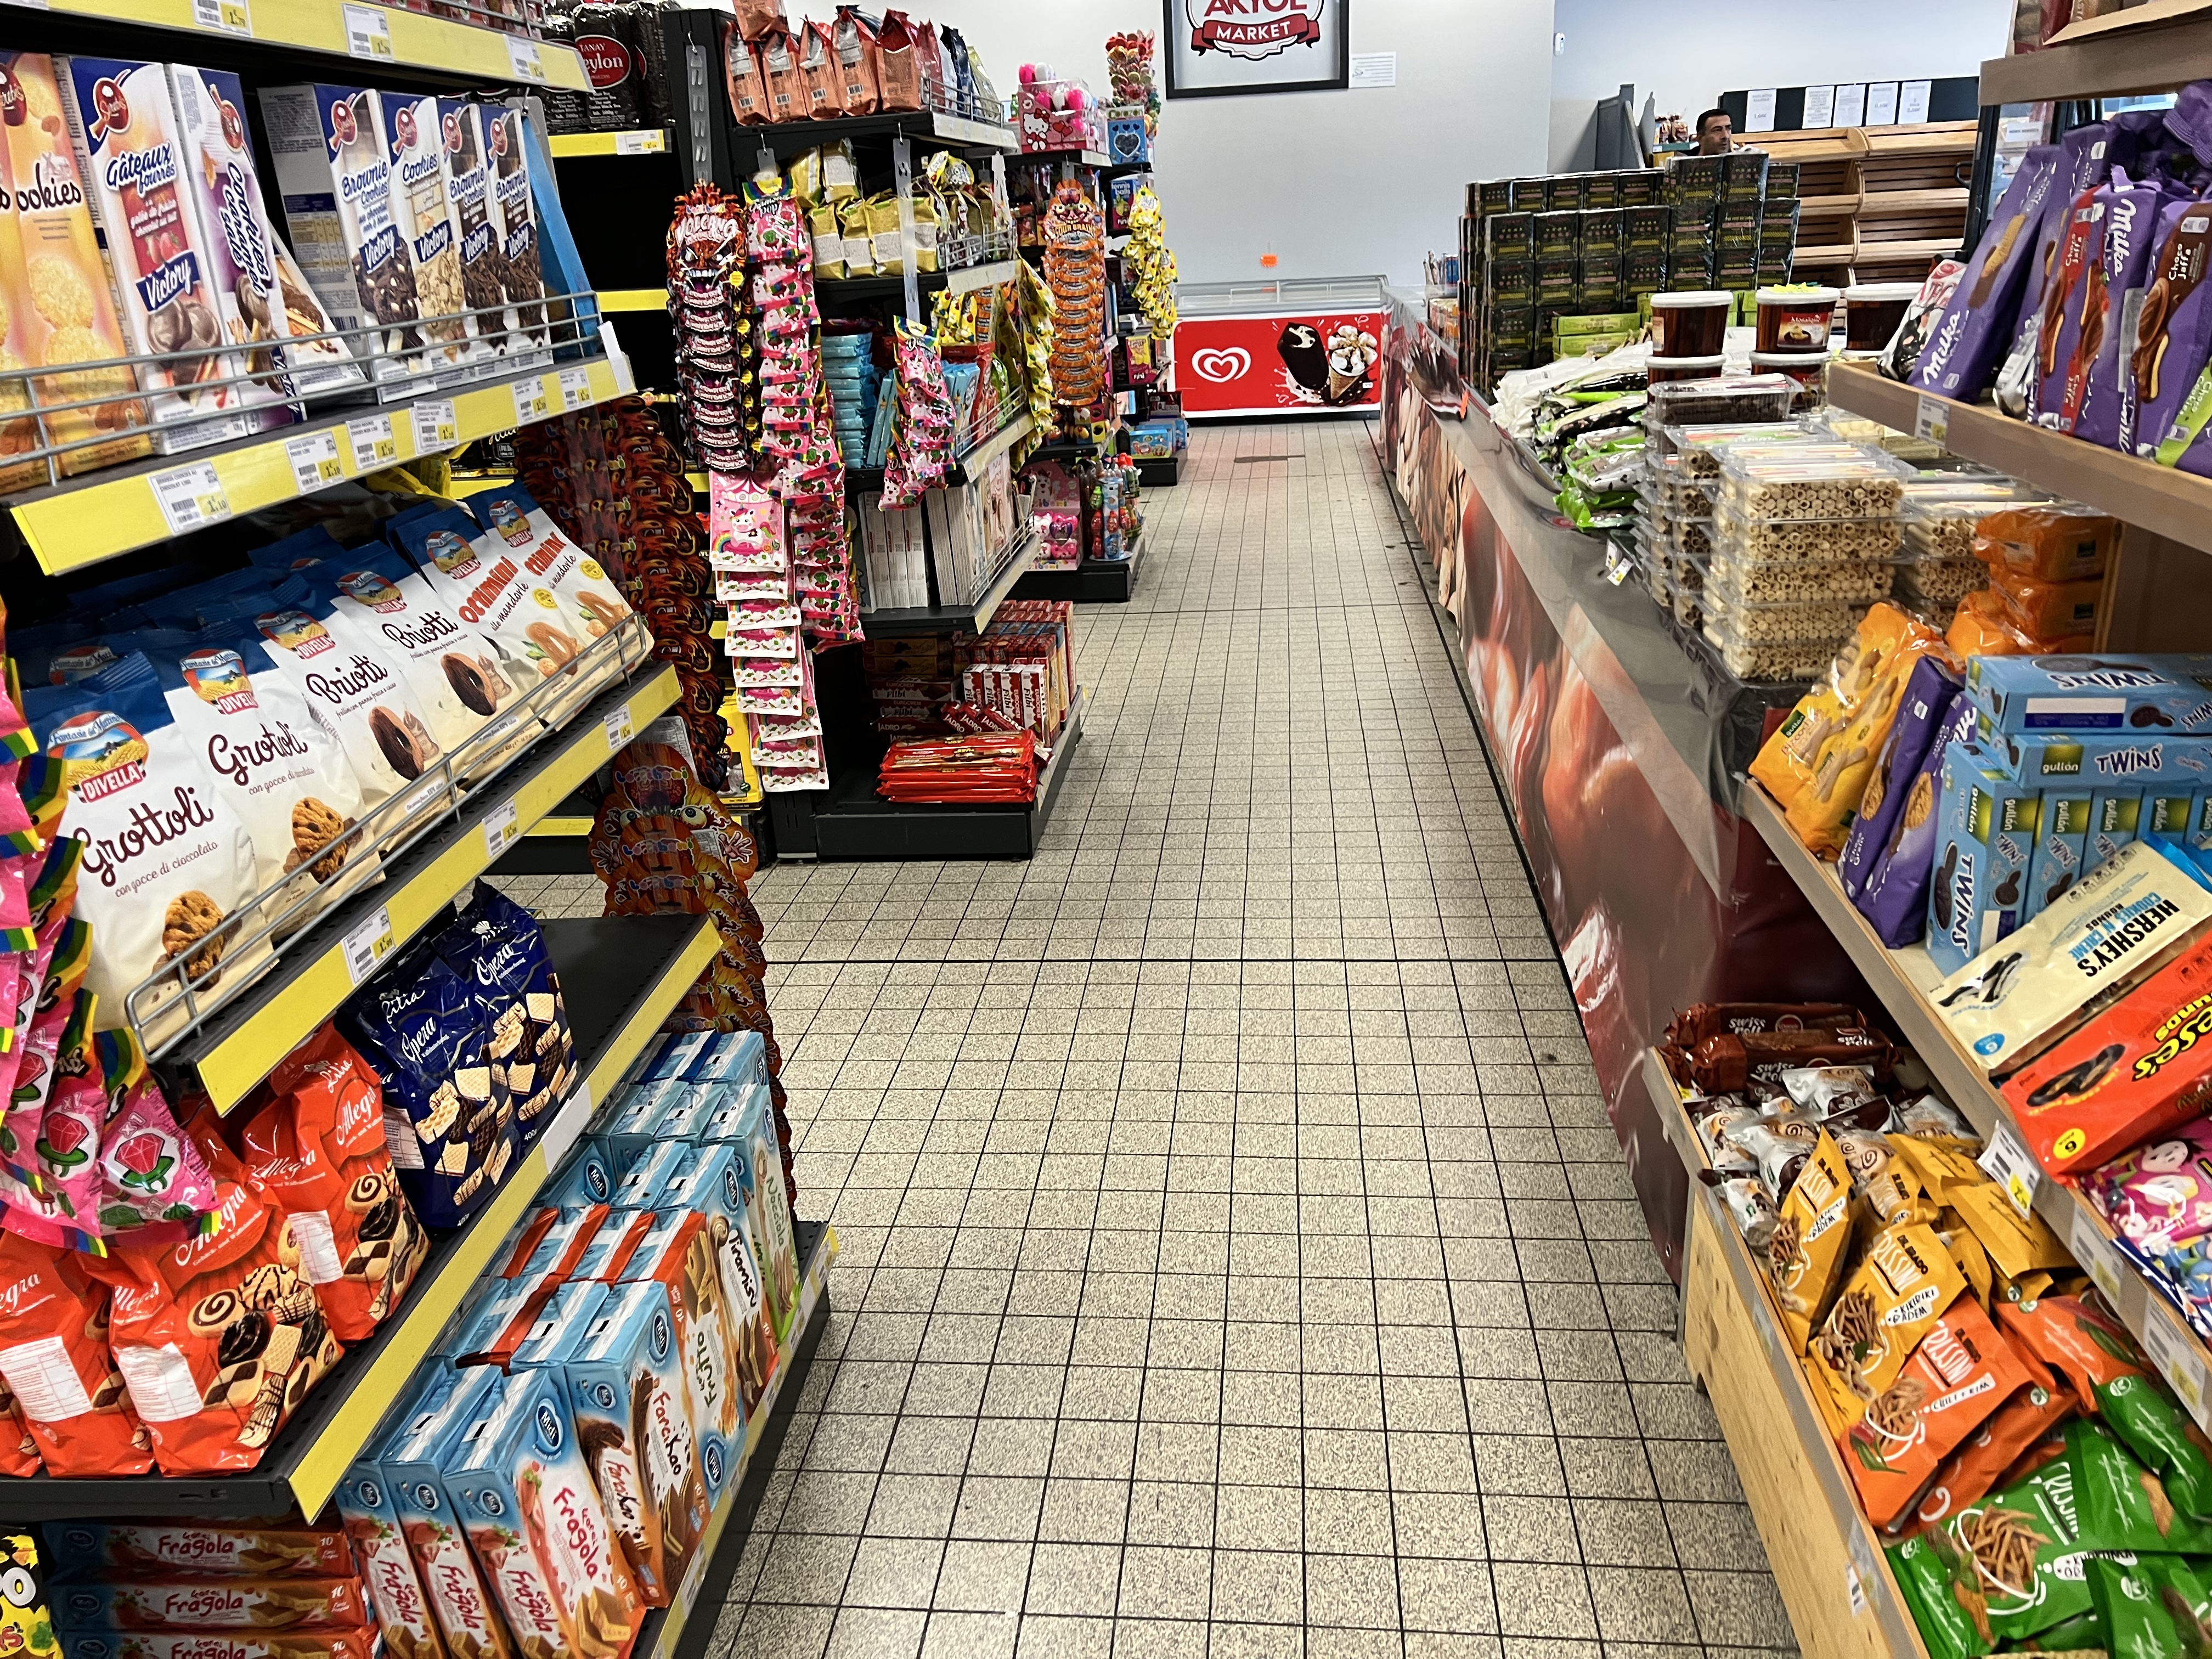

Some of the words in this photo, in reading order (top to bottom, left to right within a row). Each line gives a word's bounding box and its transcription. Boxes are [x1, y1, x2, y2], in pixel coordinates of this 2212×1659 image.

[1216, 21, 1290, 40] MARKET
[579, 43, 606, 52] TANAY
[585, 52, 623, 74] eylon
[108, 143, 173, 186] Gâteaux
[342, 163, 388, 195] Brownie
[402, 155, 437, 182] Cookies
[15, 163, 82, 212] ookies
[361, 182, 388, 205] Cookies
[450, 168, 485, 196] Brownie
[496, 168, 526, 196] Brownie
[228, 162, 270, 280] Cookies
[676, 215, 737, 247] VOLCANO
[223, 185, 267, 297] caramel
[366, 233, 394, 269] Victory
[421, 225, 448, 260] Victory
[465, 227, 489, 262] Victory
[508, 225, 532, 260] Victory
[2113, 199, 2137, 277] Milka
[145, 263, 192, 308] Victory
[1923, 311, 1961, 385] Milka
[510, 531, 532, 548] DIVELLA
[498, 582, 529, 627] mandorle
[382, 611, 459, 649] Briotti
[300, 637, 332, 658] DIVELLA
[306, 654, 388, 704] Briotti
[2050, 673, 2177, 689] TWINS
[359, 695, 373, 710] panna
[386, 682, 397, 693] cacao
[1002, 688, 1012, 711] Filbi
[1024, 687, 1032, 709] Filbi
[878, 723, 900, 731] JADRO
[944, 714, 965, 733] JADRO
[961, 714, 982, 733] JADRO
[998, 711, 1025, 731] ADRO
[2043, 757, 2079, 773] gullón
[2096, 747, 2162, 775] TWINS
[84, 766, 141, 799] DIVELLA
[1968, 788, 1978, 833] gullón
[2004, 799, 2016, 831] gullón
[2056, 800, 2068, 833] gullón
[2104, 799, 2117, 831] gullón
[2154, 799, 2166, 831] gullón
[73, 786, 215, 887] Grottoli
[1995, 833, 2028, 868] TWINS
[2047, 835, 2080, 869] TWINS
[115, 881, 133, 899] con
[132, 870, 159, 894] gocce
[159, 862, 172, 876] di
[172, 840, 219, 870] cioccolato
[1951, 854, 1975, 958] TWINS
[2085, 903, 2124, 931] ROUNDS
[2114, 891, 2163, 924] COOKIES
[2067, 926, 2104, 962] CREME
[2077, 898, 2180, 978] HERSHEY'S
[476, 940, 522, 987] Opera
[1729, 1016, 1766, 1030] swiss
[402, 1016, 437, 1063] Opera
[121, 1113, 146, 1139] x1
[589, 1167, 605, 1198] Midi
[726, 1173, 738, 1198] Midi
[766, 1176, 784, 1248] Nocciola
[656, 1318, 668, 1352] Midi
[540, 1409, 559, 1448] Midi
[653, 1390, 682, 1476] FarciKao
[708, 1446, 722, 1479] Midi
[694, 1481, 703, 1496] 10
[158, 1534, 234, 1559] Fragola
[320, 1536, 334, 1547] 10
[553, 1486, 599, 1580] Fragola
[331, 1585, 345, 1599] 10
[377, 1559, 418, 1626] Fragola
[438, 1564, 485, 1632] Fragola
[617, 1575, 627, 1590] 10
[165, 1588, 243, 1614] Fragola
[506, 1568, 559, 1634] Fragola
[171, 1639, 246, 1659] Fragola
[332, 1640, 345, 1654] 10
